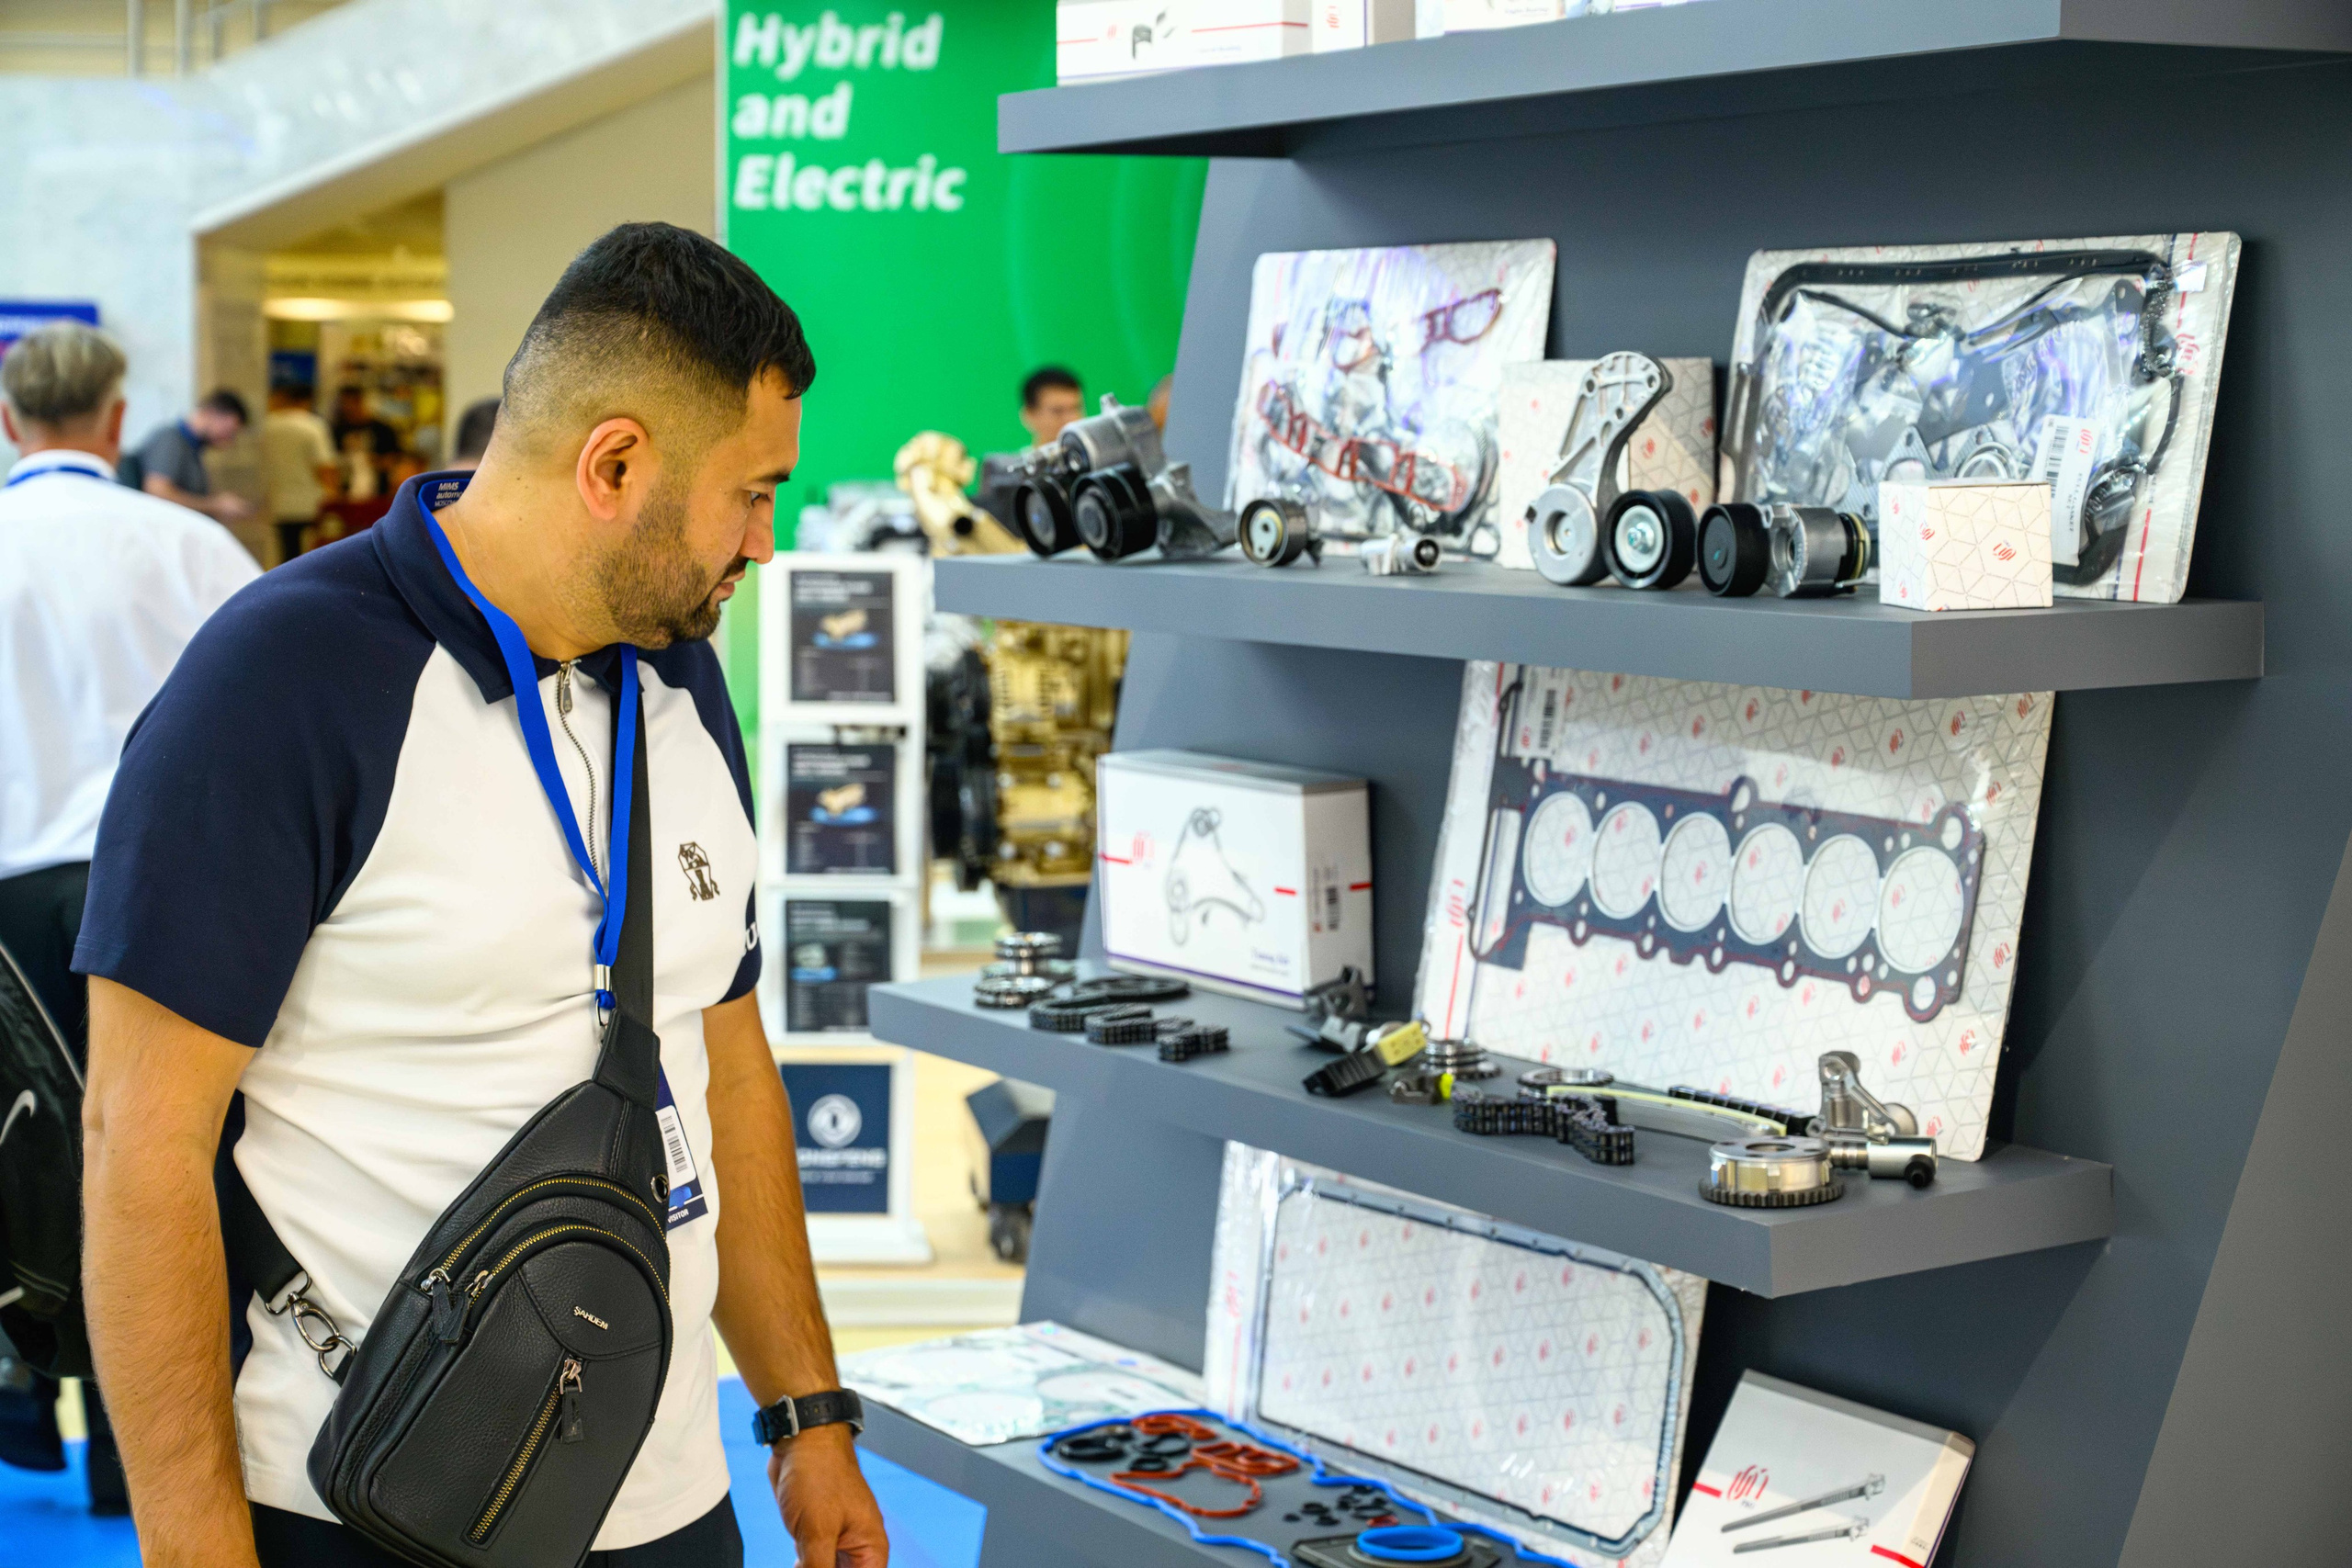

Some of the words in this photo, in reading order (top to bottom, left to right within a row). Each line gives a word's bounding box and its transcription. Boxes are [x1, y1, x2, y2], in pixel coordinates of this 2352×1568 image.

[733, 10, 944, 82] Hybrid
[732, 80, 854, 140] and
[733, 151, 967, 211] Electric
[438, 481, 459, 491] MIMS
[667, 1208, 689, 1224] VISITOR
